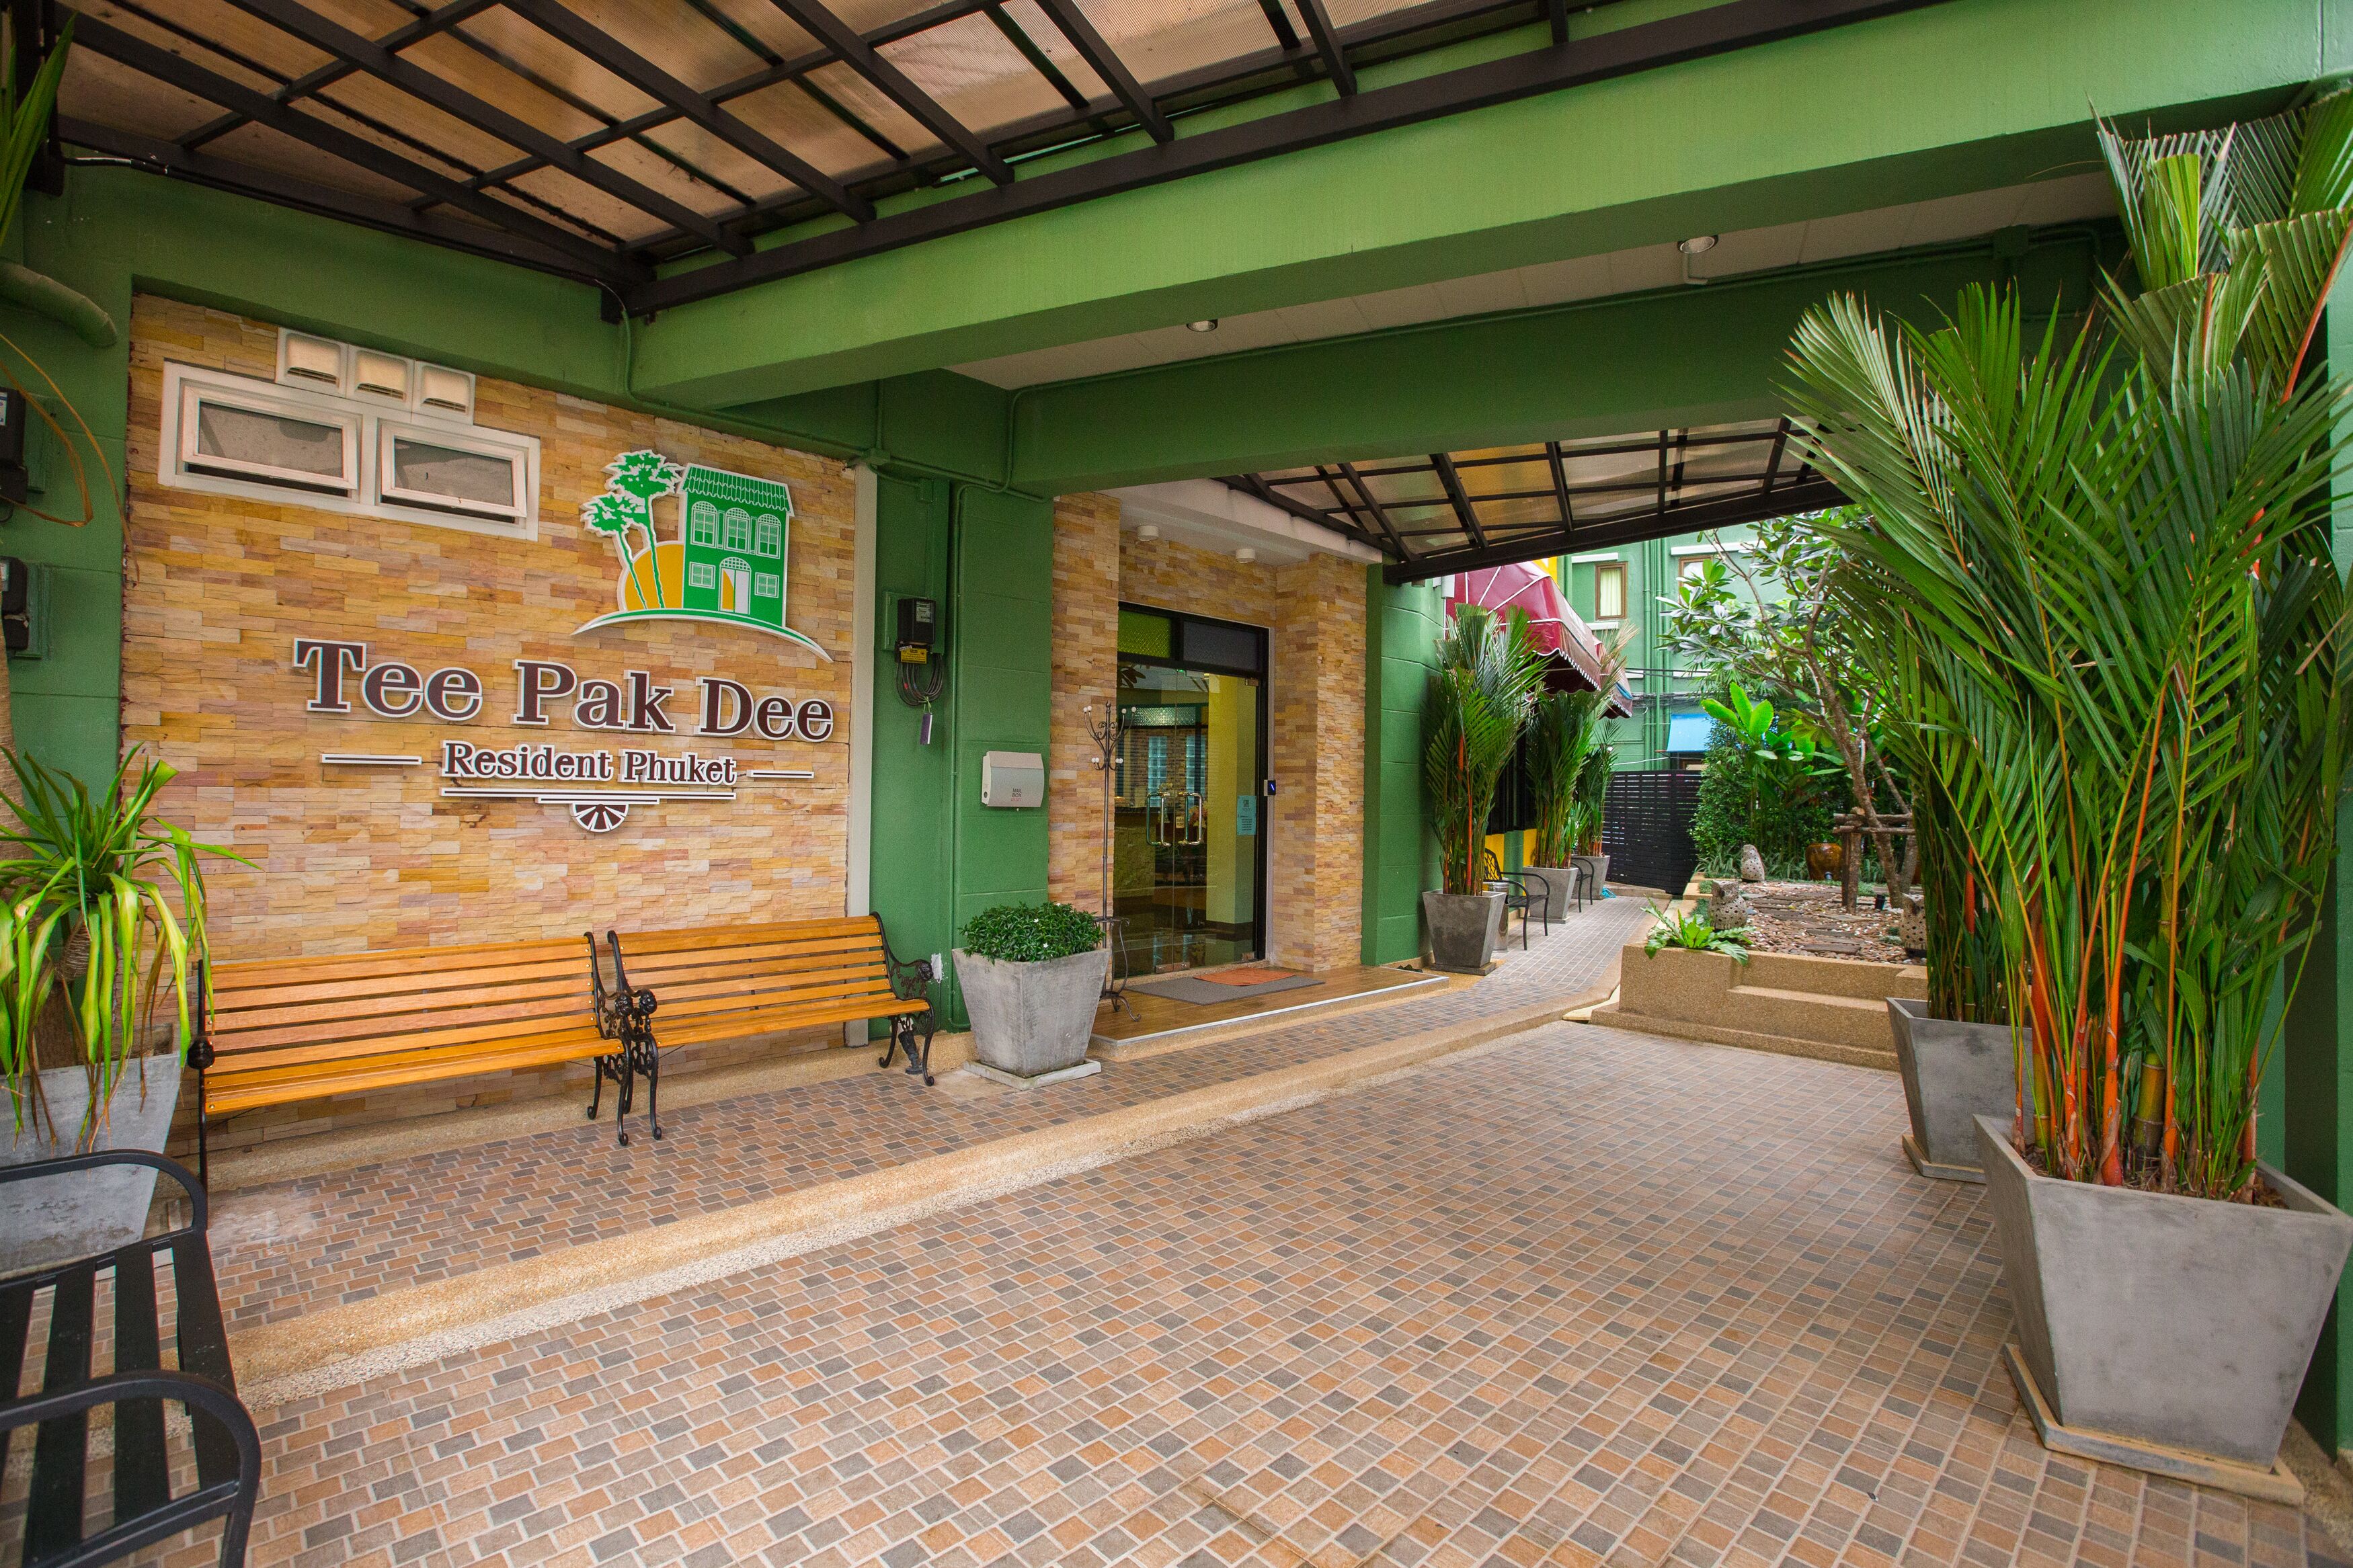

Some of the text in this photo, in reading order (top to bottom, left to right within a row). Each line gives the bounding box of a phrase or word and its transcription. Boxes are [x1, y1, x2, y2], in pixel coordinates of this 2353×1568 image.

[294, 638, 833, 742] Tee Pak Dee
[442, 740, 737, 785] Resident Phuket
